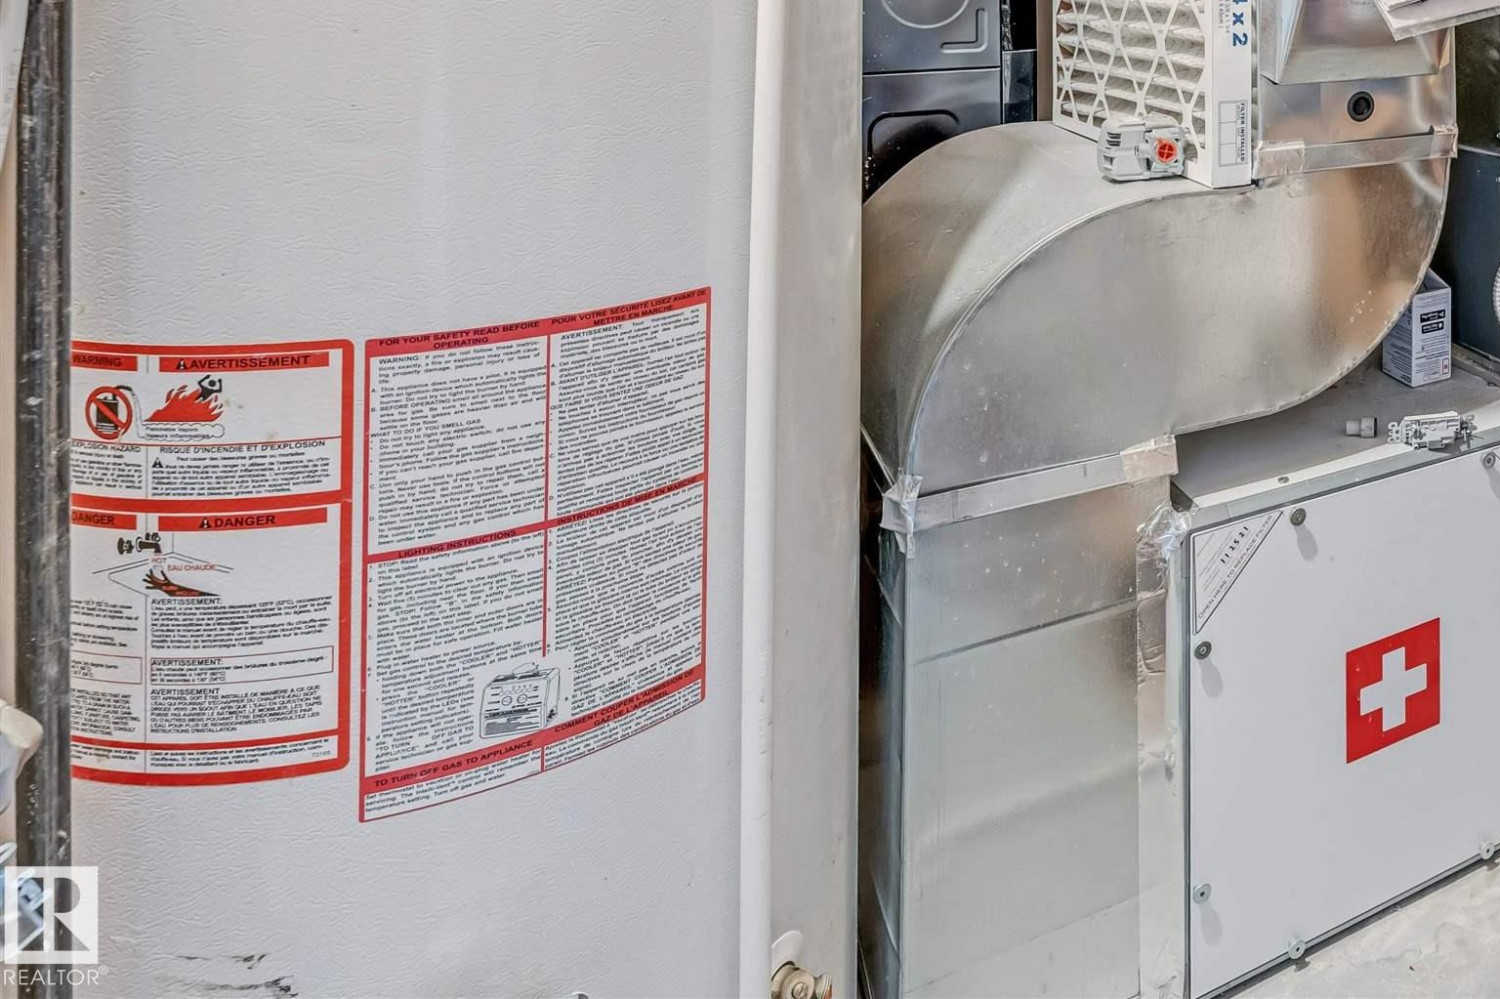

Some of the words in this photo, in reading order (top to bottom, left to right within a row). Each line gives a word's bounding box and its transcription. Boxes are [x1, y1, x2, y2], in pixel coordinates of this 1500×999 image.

[1232, 12, 1244, 26] x
[1232, 32, 1248, 47] 2
[551, 316, 577, 325] POUR
[579, 310, 606, 320] VOTRE
[673, 292, 695, 302] AVANT
[593, 315, 625, 325] METTRE
[642, 305, 673, 316] MARCHE
[403, 335, 431, 344] YOUR
[433, 330, 471, 341] SAFETY
[473, 326, 499, 336] READ
[502, 321, 539, 332] BEFORE
[433, 337, 489, 349] OPERATING
[72, 355, 122, 367] WARNING
[189, 355, 310, 370] AVERTISSEMENT
[441, 421, 464, 430] SMELL
[160, 446, 192, 454] RISQUE
[193, 445, 244, 454] D'INCENDIE
[261, 440, 326, 452] D'EXPLOSION
[557, 503, 619, 525] INSTRUCTIONS
[622, 499, 633, 507] DE
[635, 493, 653, 503] MISE
[667, 477, 697, 493] MARCHE
[214, 515, 275, 528] DANGER
[399, 544, 445, 558] LIGHTING
[447, 530, 517, 549] INSTRUCTIONS
[554, 713, 598, 732] COMMENT
[600, 698, 634, 715] COUPER
[636, 675, 683, 700] L'ADMISSION
[684, 670, 694, 678] DE
[594, 717, 611, 726] GAZ
[613, 710, 625, 719] DE
[374, 779, 388, 787] TO
[391, 772, 418, 783] TURN
[420, 767, 439, 777] OFF
[444, 760, 463, 772] GAS
[466, 756, 478, 765] TO
[480, 740, 534, 761] APPLIANCE
